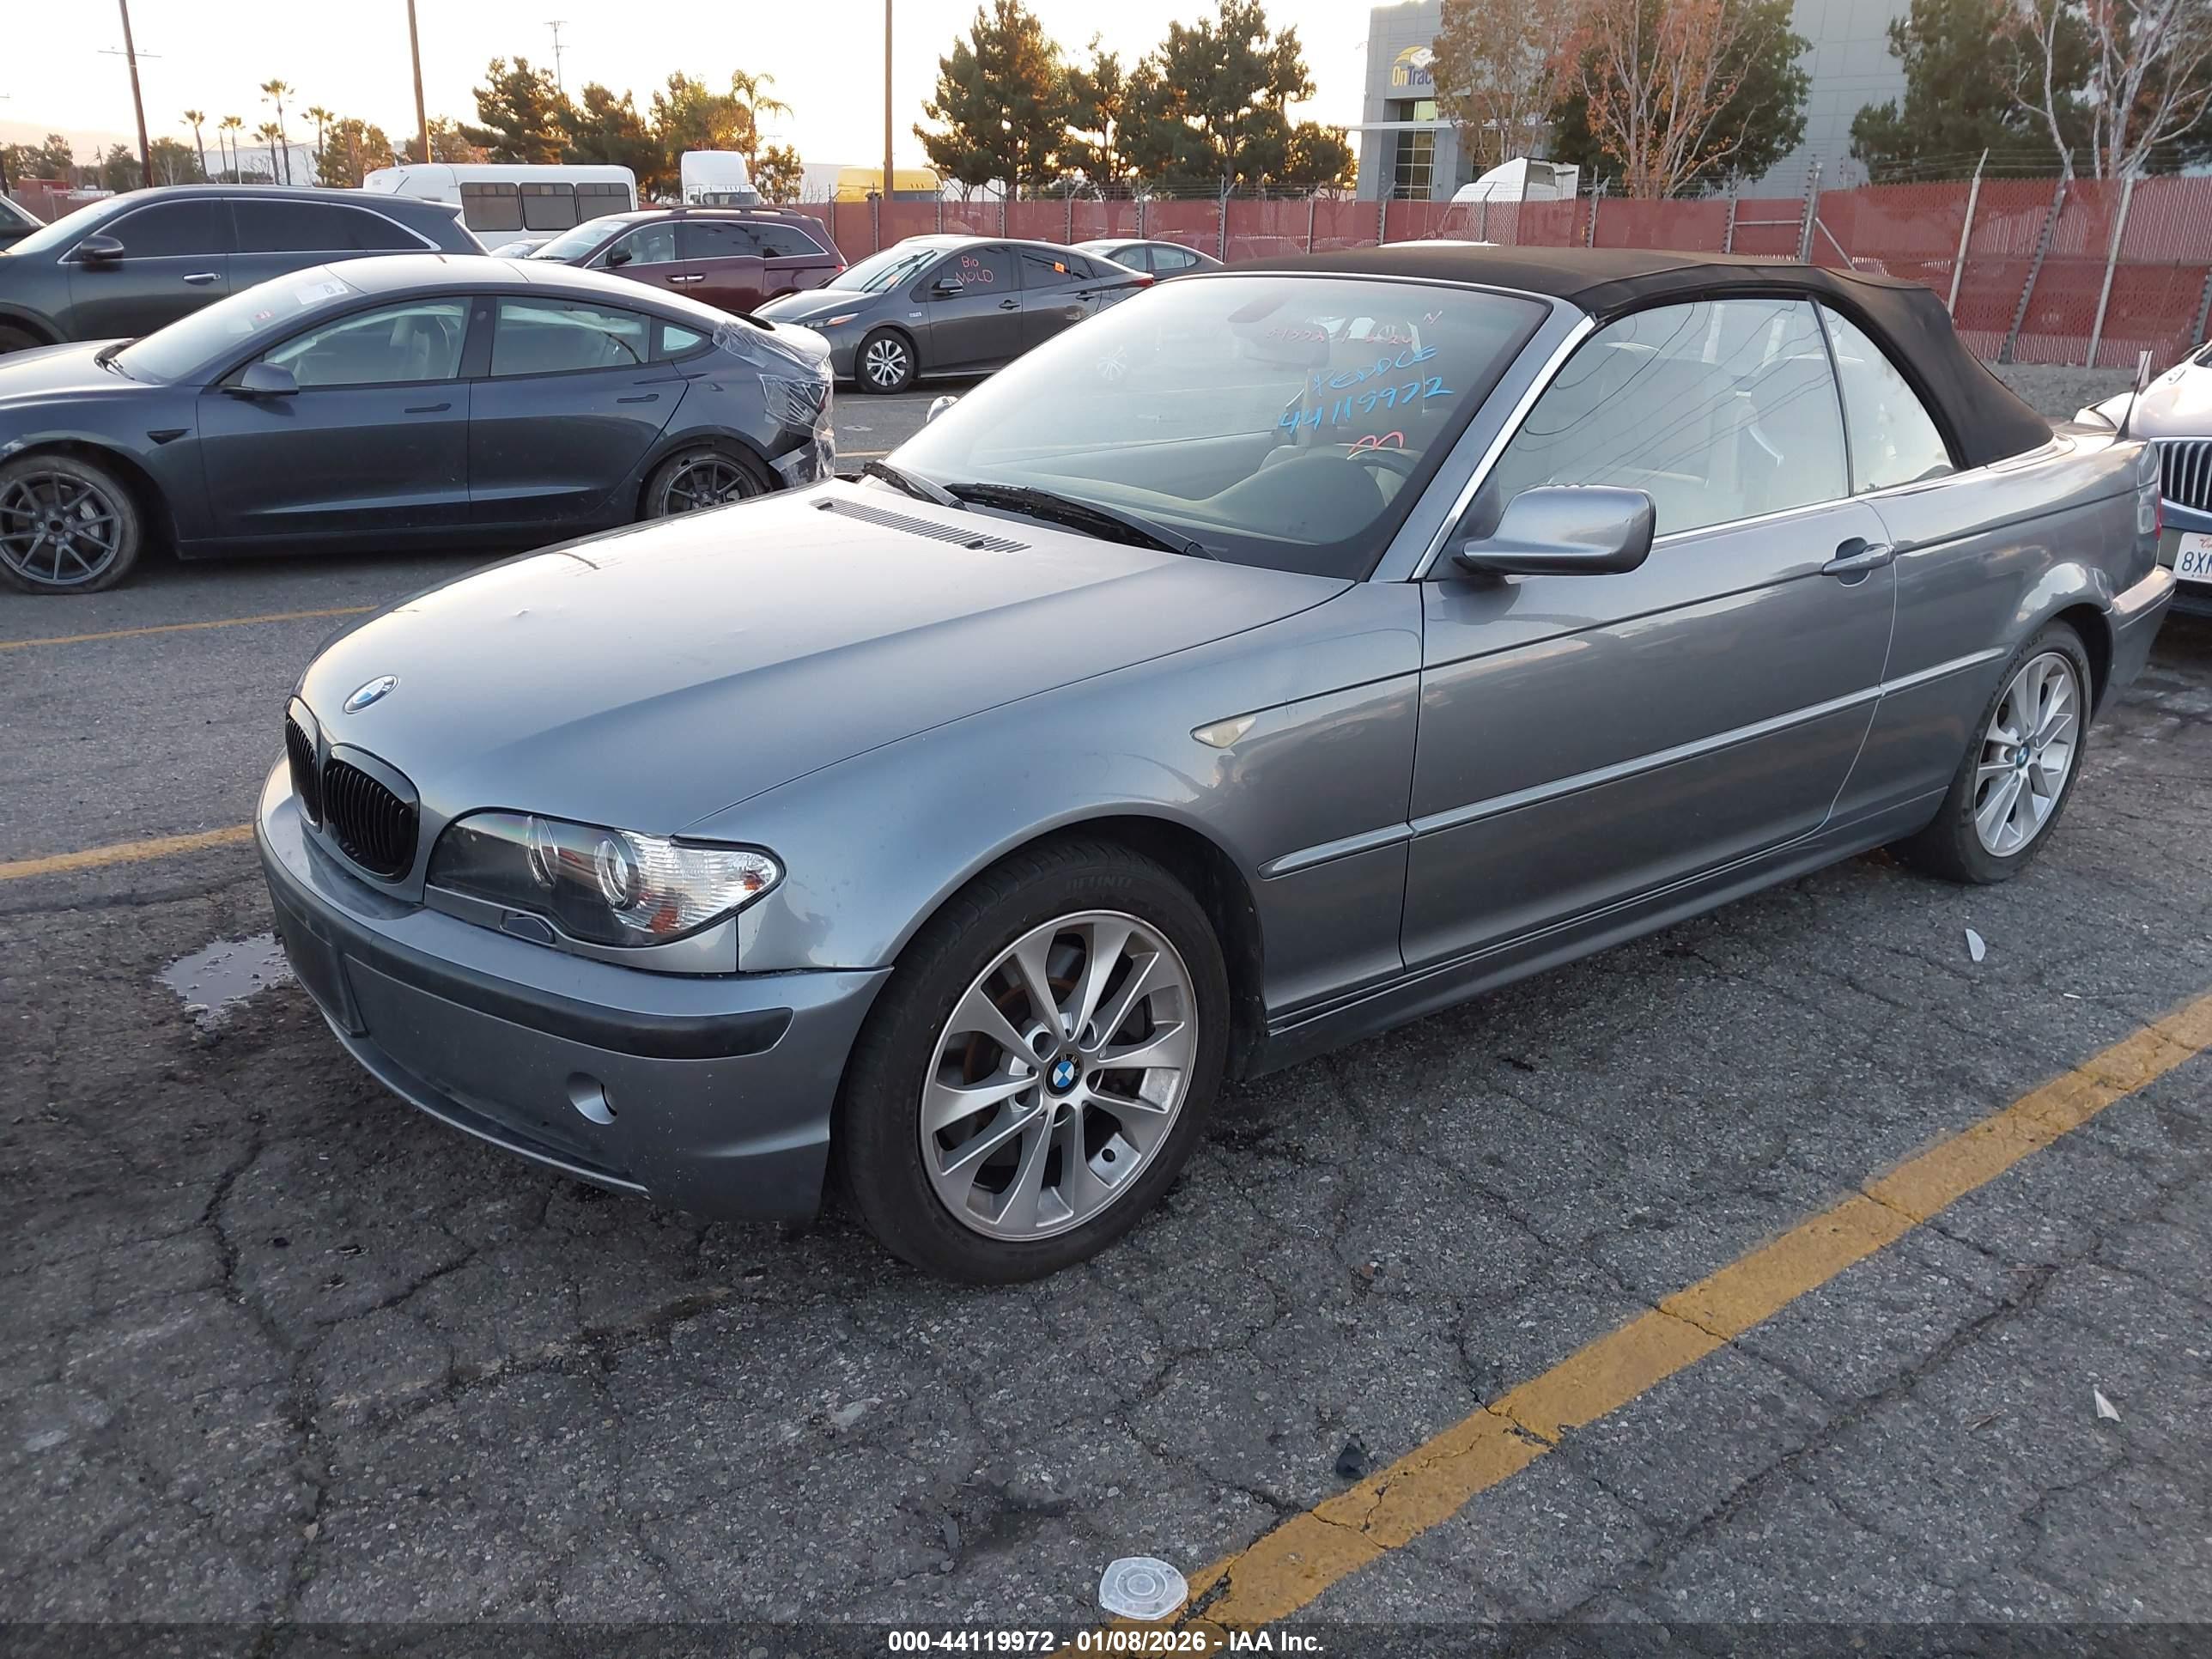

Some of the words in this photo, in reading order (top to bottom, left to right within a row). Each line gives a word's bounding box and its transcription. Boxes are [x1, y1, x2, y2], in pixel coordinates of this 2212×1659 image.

[1391, 65, 1432, 86] OnTrac
[955, 269, 994, 283] MOLD
[1279, 376, 1455, 434] 44119972
